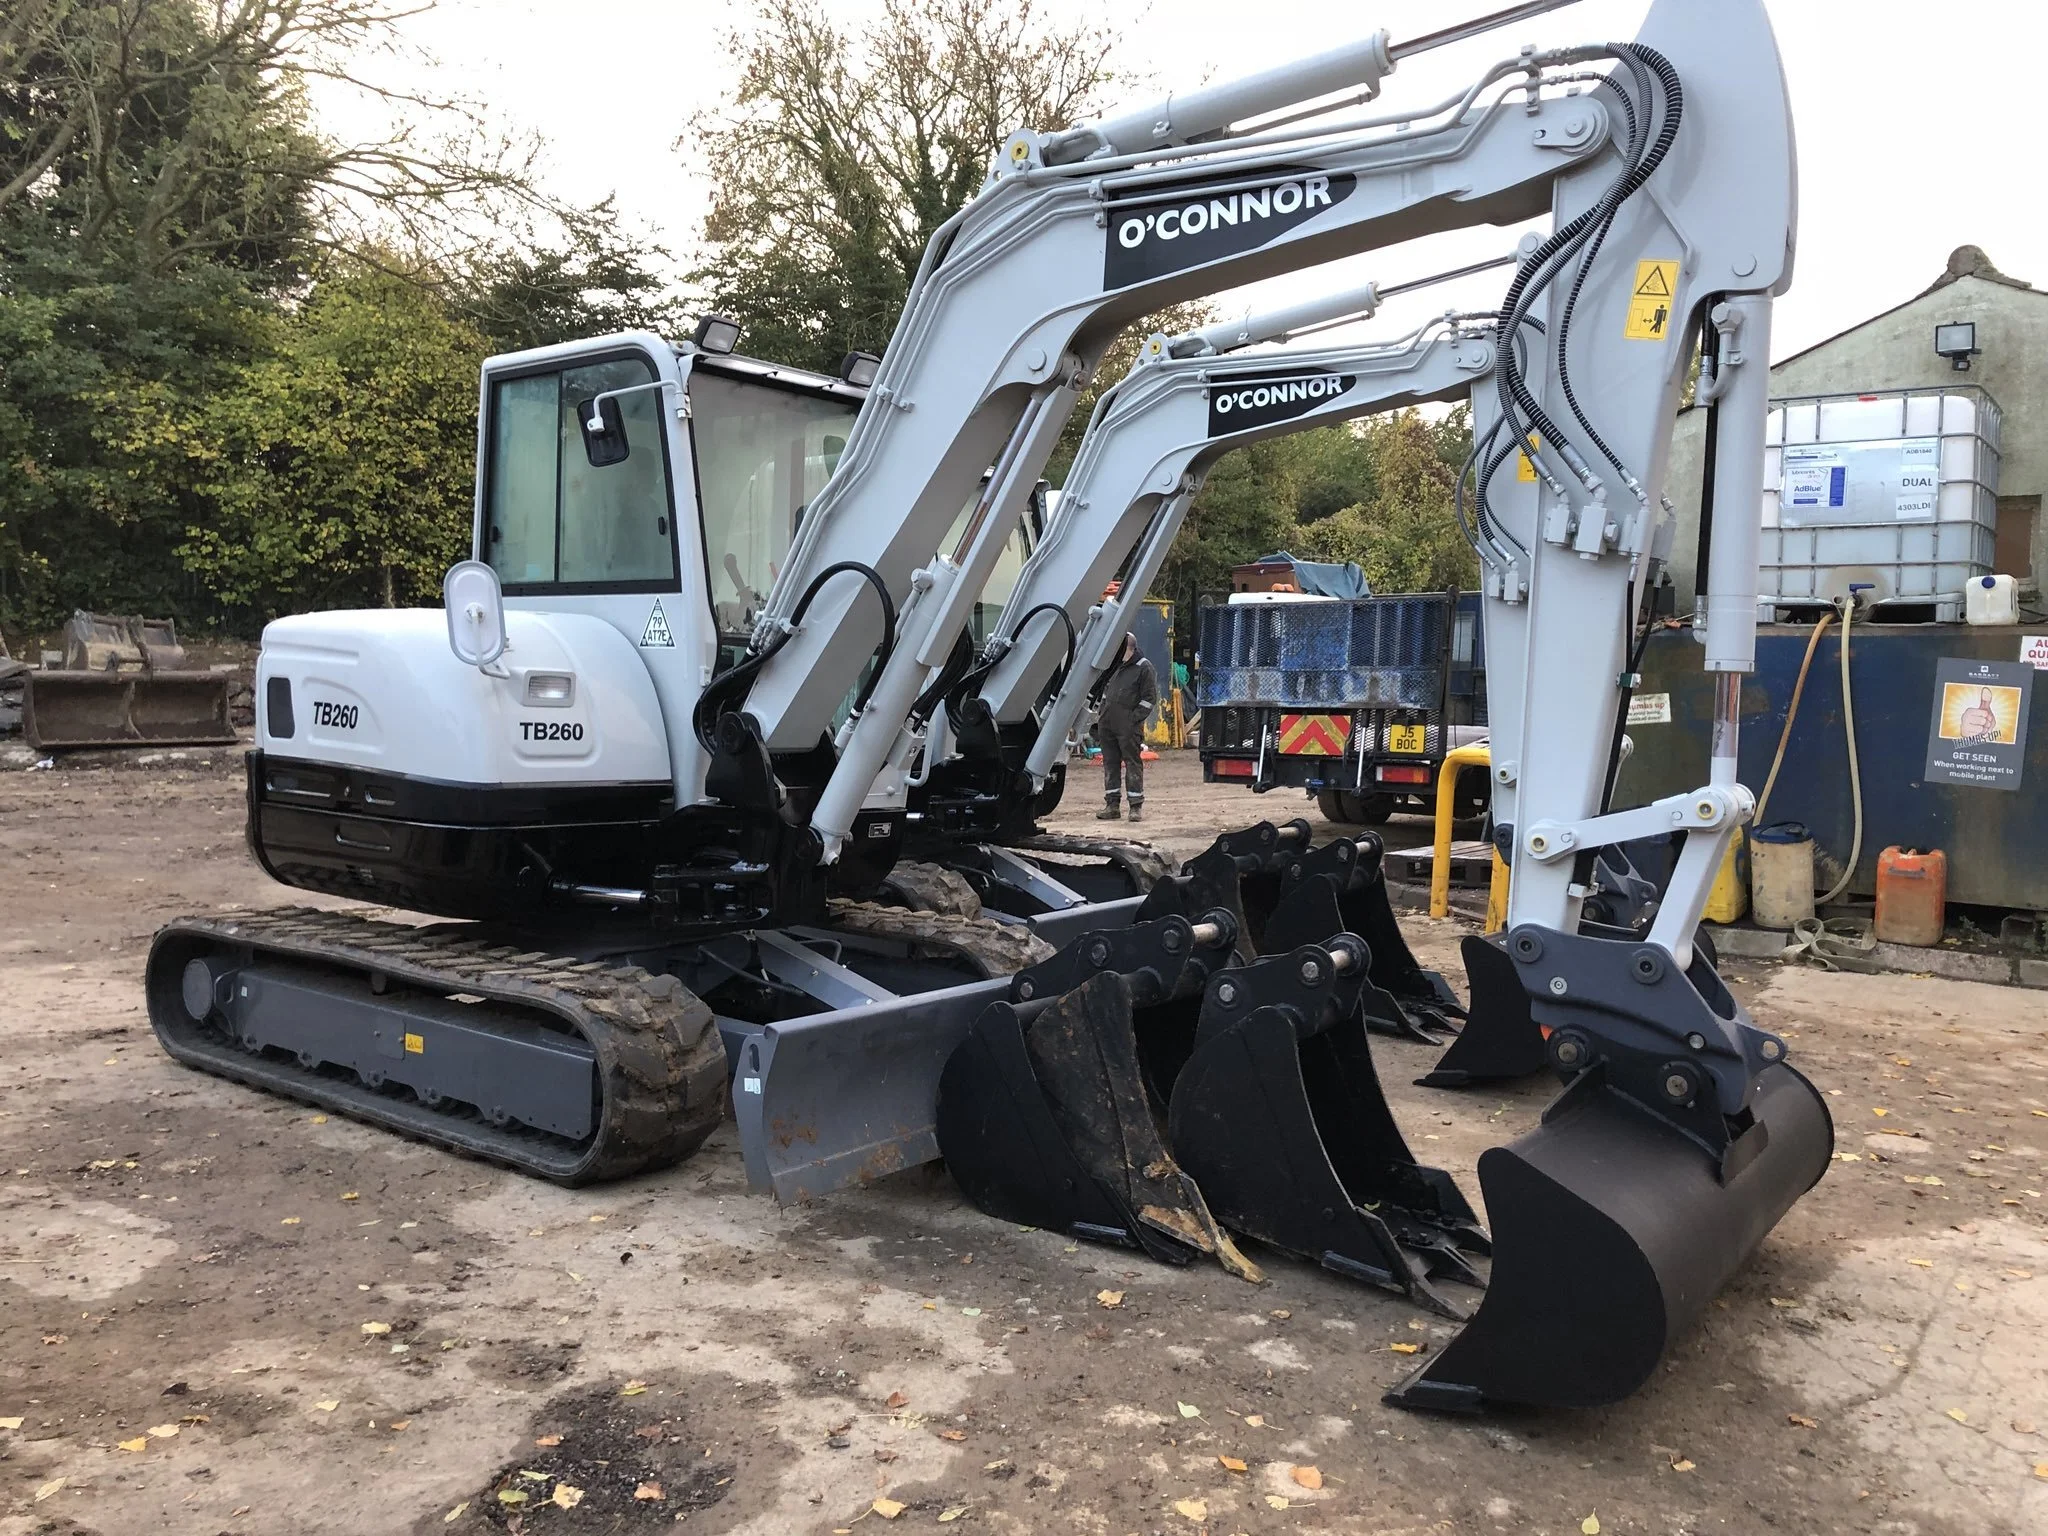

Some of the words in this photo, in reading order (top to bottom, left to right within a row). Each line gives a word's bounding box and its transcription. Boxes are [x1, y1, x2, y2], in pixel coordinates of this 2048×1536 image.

[1118, 175, 1333, 249] O'CONNOR
[1215, 376, 1344, 414] O'CONNOR
[1902, 477, 1933, 487] DUAL
[652, 616, 663, 629] 79
[2028, 649, 2048, 659] QU
[313, 701, 359, 729] TB260
[520, 721, 584, 742] TB260
[1401, 727, 1414, 738] J5
[1396, 739, 1417, 749] BOC
[1952, 751, 1971, 761] GET
[1972, 753, 1997, 764] SEEN
[1933, 759, 1955, 769] When
[1956, 762, 1987, 773] working
[2006, 767, 2014, 775] to
[1949, 771, 1975, 779] mobile
[1976, 773, 1996, 782] plant
